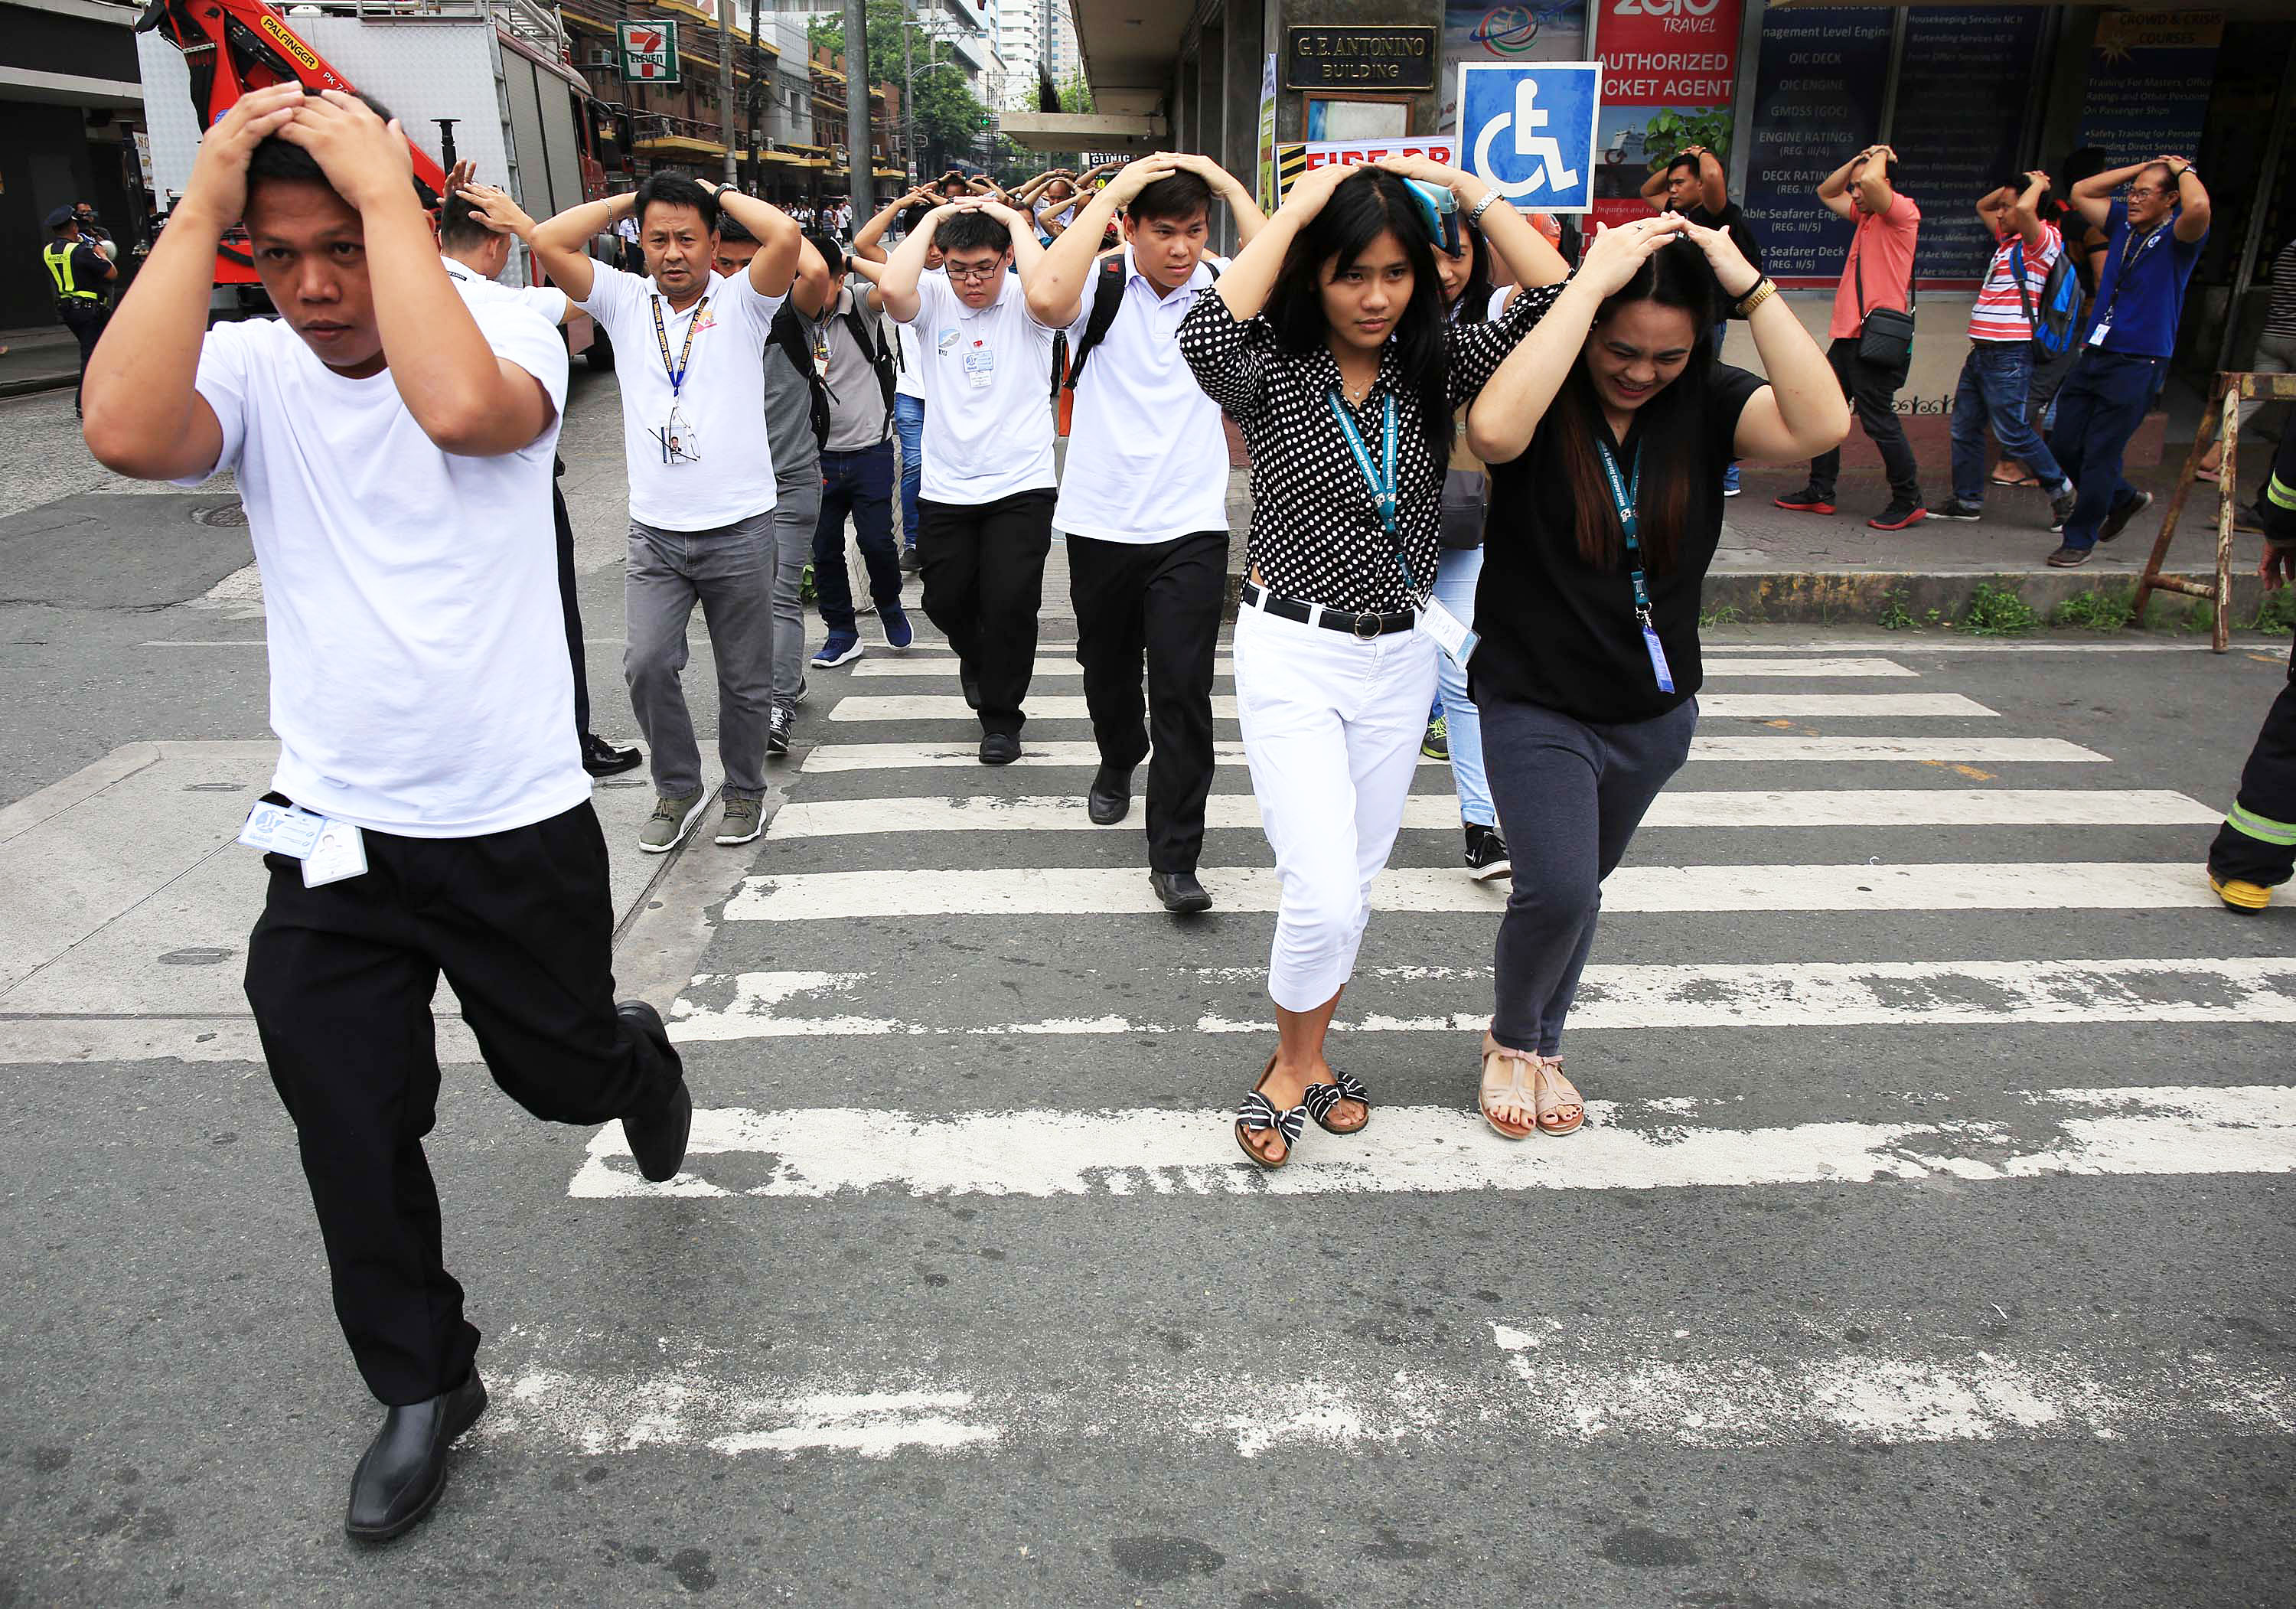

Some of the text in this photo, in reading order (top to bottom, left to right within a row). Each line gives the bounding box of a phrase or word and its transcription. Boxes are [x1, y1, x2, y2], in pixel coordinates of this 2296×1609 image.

[1969, 14, 2001, 24] Services
[2119, 12, 2167, 24] CROWD
[2183, 12, 2222, 24] CRISIS
[1663, 18, 1716, 32] TRAVEL
[1763, 26, 1819, 40] nagement
[1823, 25, 1851, 37] Level
[2138, 31, 2196, 44] COURSES
[264, 18, 315, 67] PALFINGER
[1333, 37, 1427, 56] ANTONINO
[1597, 53, 1728, 70] AUTHORIZED
[1789, 53, 1843, 64] OIC DECK
[1322, 64, 1400, 78] BUILDING
[323, 72, 337, 85] PK
[1605, 79, 1733, 97] CKET AGENT
[1779, 80, 1844, 92] OIC ENGINE
[1770, 106, 1812, 117] GMDSS
[1760, 132, 1855, 143] ENGINE RATINGS
[2118, 129, 2151, 139] Training
[1779, 145, 1805, 158] (REG.
[1091, 154, 1130, 164] CLINIC
[1763, 170, 1831, 181] DECK RATIN
[1777, 183, 1802, 194] (REG.
[1742, 208, 1766, 220] Able
[1769, 208, 1815, 220] Seafarer
[1771, 222, 1821, 233] (REG. III/5)
[1769, 245, 1816, 256] Seafarer
[1818, 245, 1844, 256] Deck
[1769, 259, 1816, 270] (REG. II/5)
[1387, 411, 1395, 428] Surety
[1339, 413, 1355, 439] Insurance
[1353, 443, 1365, 462] Surety
[1361, 460, 1379, 491] Corporation
[1606, 458, 1616, 475] Surety
[1612, 475, 1626, 507] Corporation
